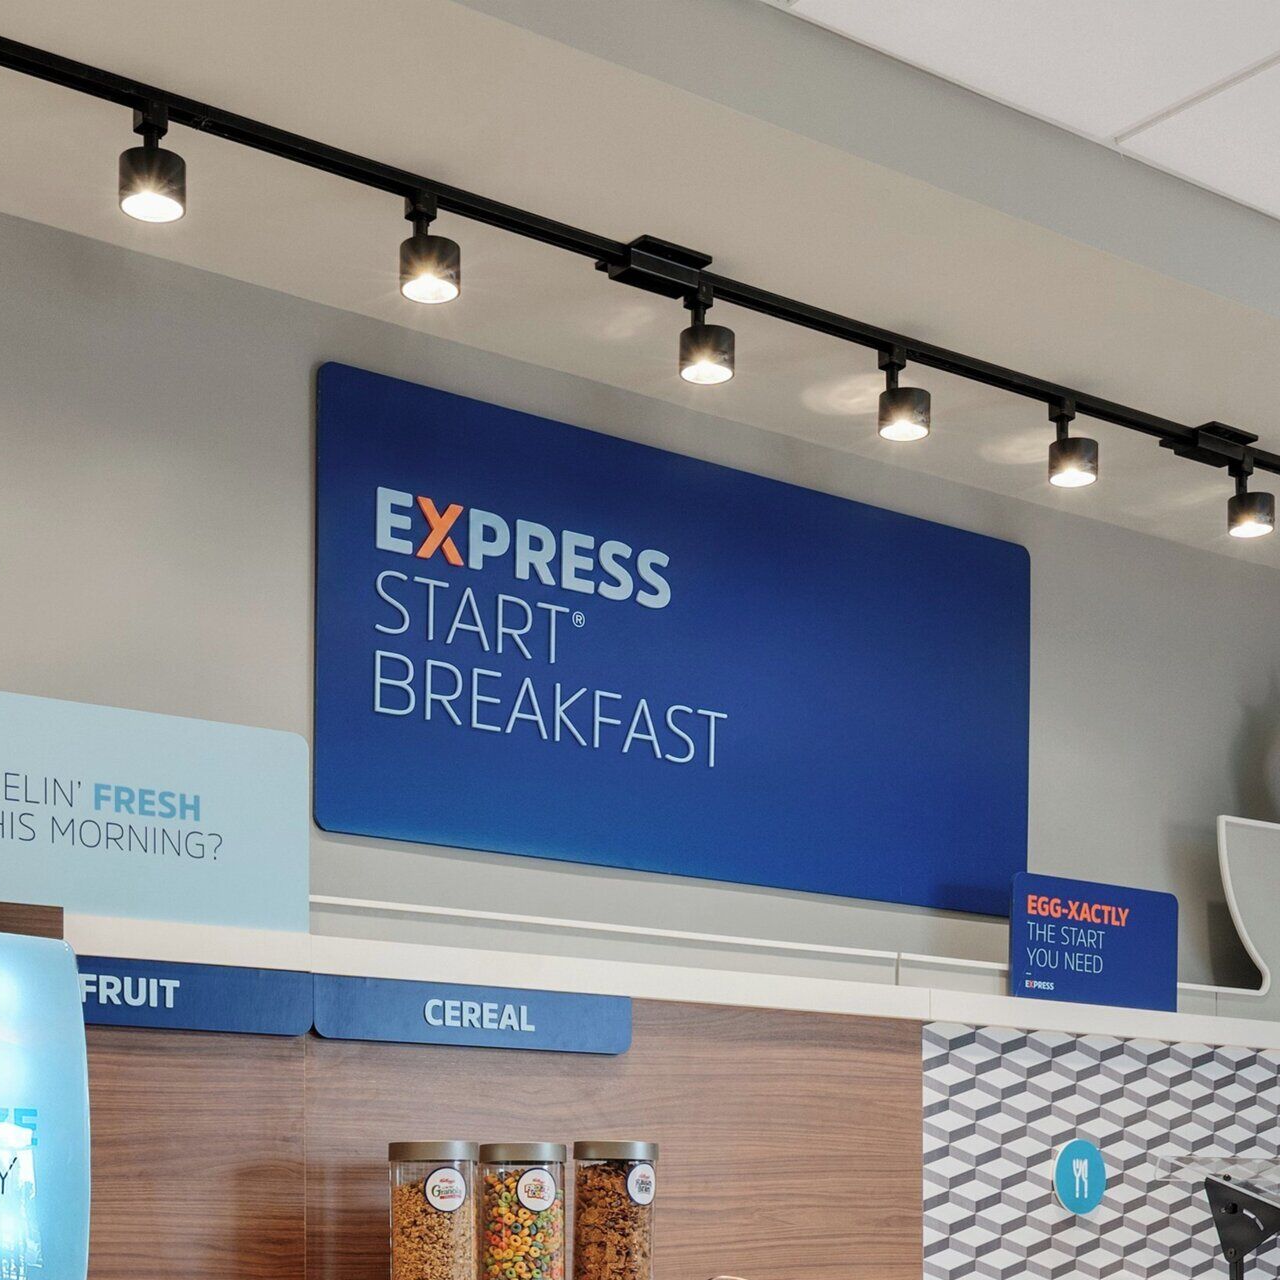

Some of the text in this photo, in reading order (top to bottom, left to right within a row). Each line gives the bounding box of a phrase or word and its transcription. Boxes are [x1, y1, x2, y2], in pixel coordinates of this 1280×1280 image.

[376, 486, 672, 609] EXPRESS
[374, 650, 728, 768] BREAKFAST
[93, 783, 201, 822] FRESH
[50, 815, 223, 861] MORNING?
[1026, 894, 1130, 927] EGG-XACTLY
[1026, 921, 1106, 950] THE START
[1026, 947, 1104, 974] YOU NEED
[78, 973, 180, 1008] FRUIT
[1025, 979, 1055, 991] EXPRESS
[424, 999, 536, 1032] CEREAL
